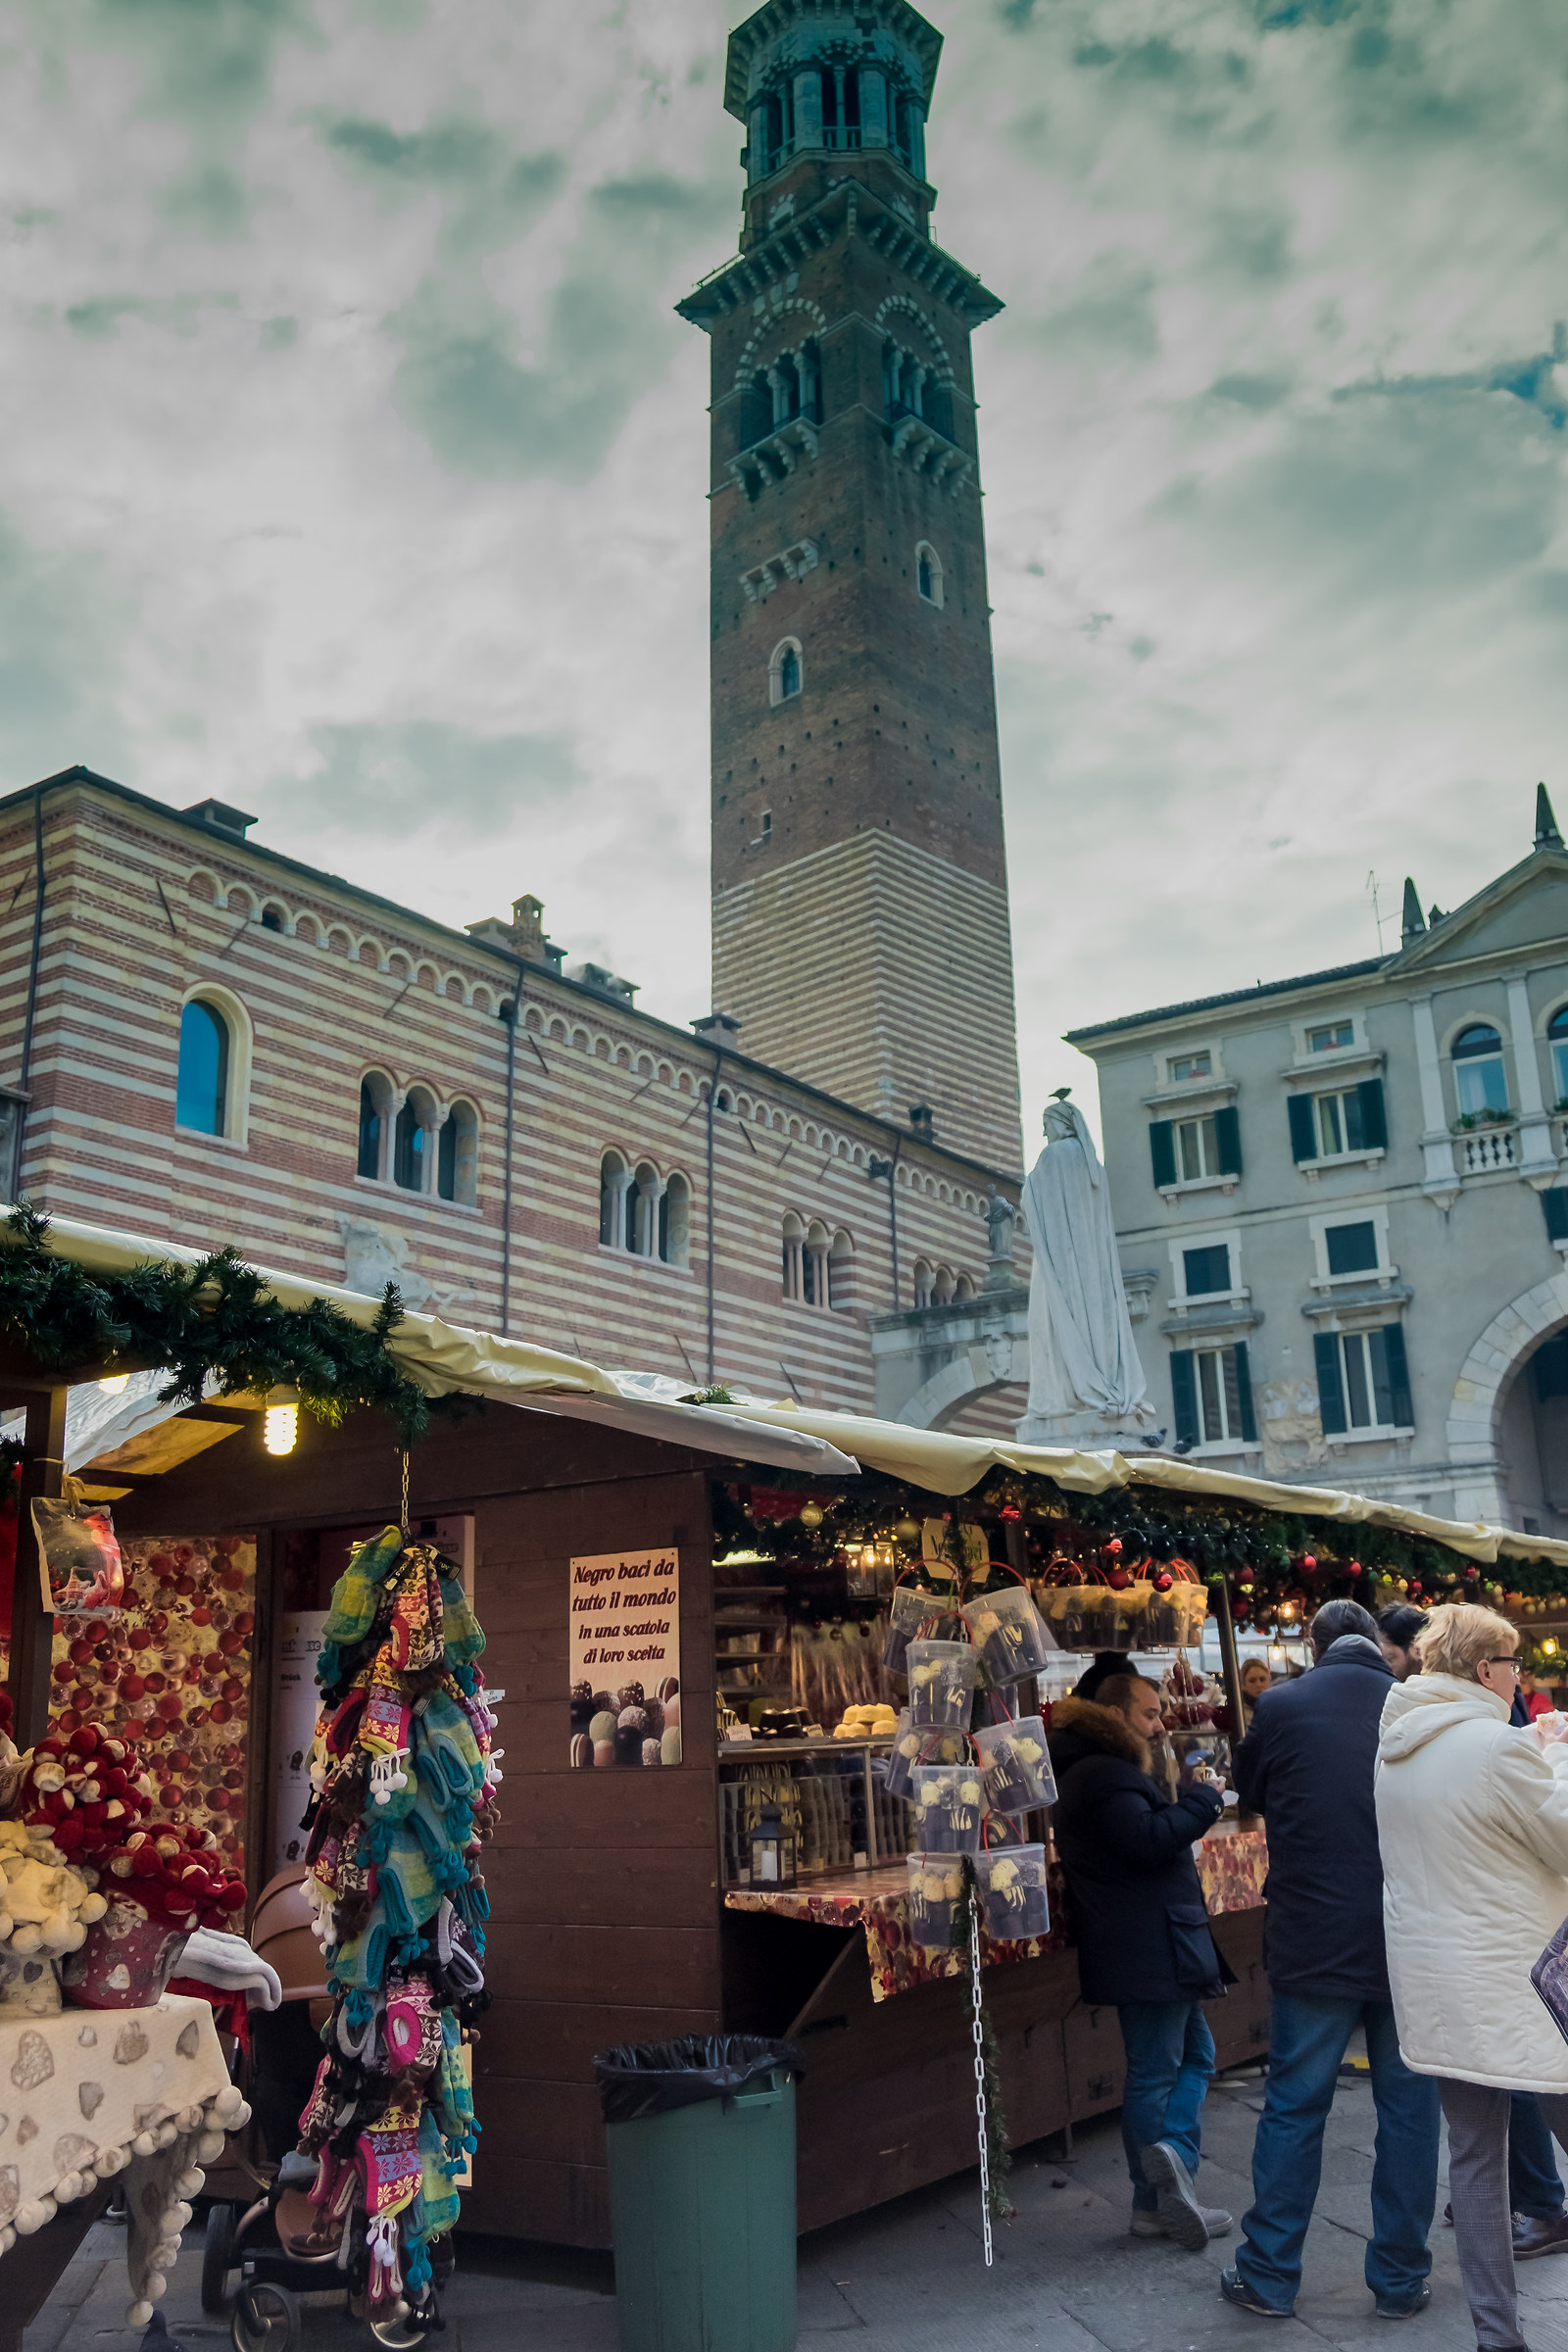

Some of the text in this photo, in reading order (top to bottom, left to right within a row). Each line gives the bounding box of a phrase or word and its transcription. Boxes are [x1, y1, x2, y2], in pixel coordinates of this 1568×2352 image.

[574, 1558, 675, 1587] Negro baci da
[572, 1588, 676, 1612] tutto il mondo
[578, 1619, 670, 1640] in una scatola
[583, 1644, 665, 1664] di loro scelta
